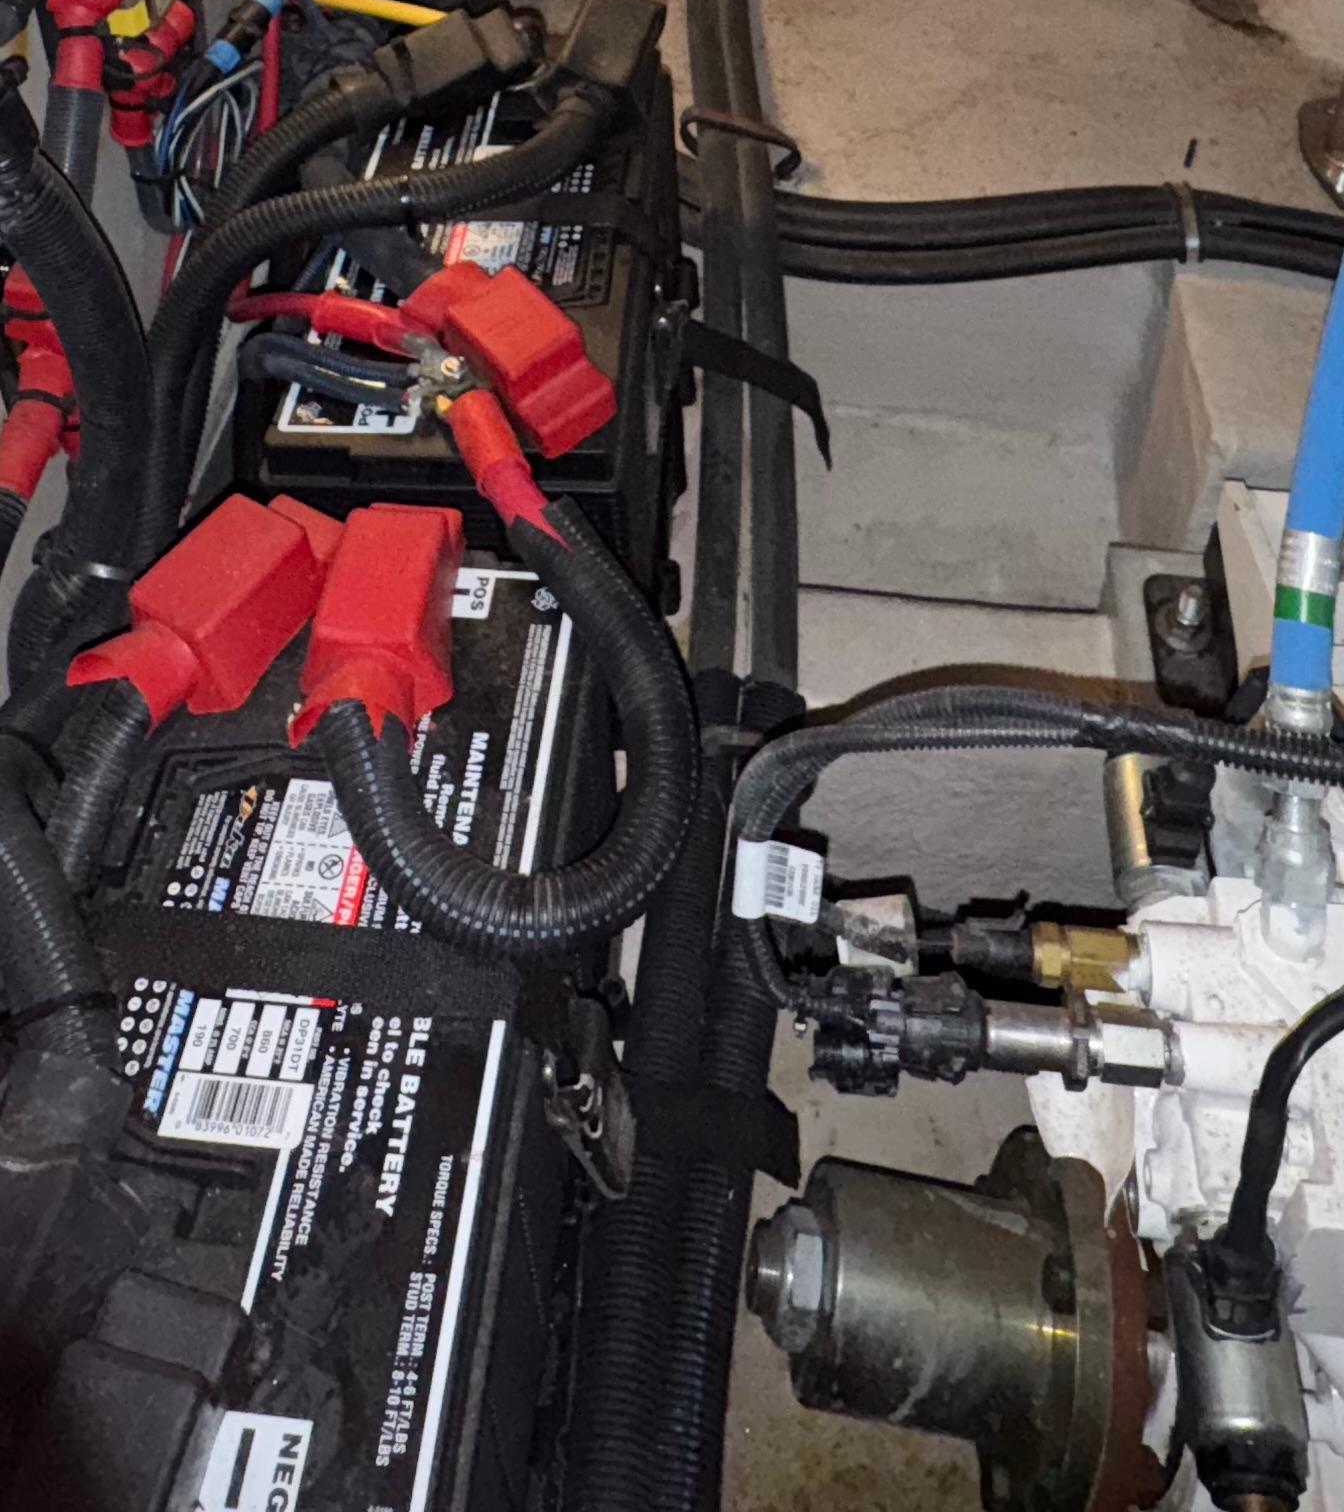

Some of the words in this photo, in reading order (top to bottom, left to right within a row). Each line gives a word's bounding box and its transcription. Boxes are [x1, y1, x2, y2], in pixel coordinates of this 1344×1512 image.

[470, 577, 489, 611] POS
[426, 753, 446, 790] fluid
[143, 988, 195, 1113] MASTER
[192, 1023, 207, 1047] 190
[226, 1026, 242, 1051] 700
[258, 1030, 273, 1054] 860
[288, 1018, 311, 1073] DP31DT
[381, 1041, 399, 1064] to
[306, 1054, 337, 1133] AMERICAN
[360, 1059, 378, 1081] in
[321, 1057, 351, 1139] VIBRATION
[366, 1068, 391, 1136] check
[338, 1085, 369, 1173] service.
[375, 1074, 421, 1218] BATTERY
[295, 1133, 315, 1179] MADE
[432, 1154, 453, 1207] TORQUE
[294, 1141, 330, 1246] RESISTANCE
[270, 1183, 304, 1282] RELIABILITY
[405, 1271, 423, 1311] STUD
[419, 1273, 437, 1310] POST
[385, 1369, 405, 1406] 8-10
[403, 1370, 419, 1395] 4-6
[375, 1408, 398, 1467] FT/LBS
[392, 1400, 414, 1454] FT/LBS
[266, 1433, 303, 1512] NEG
